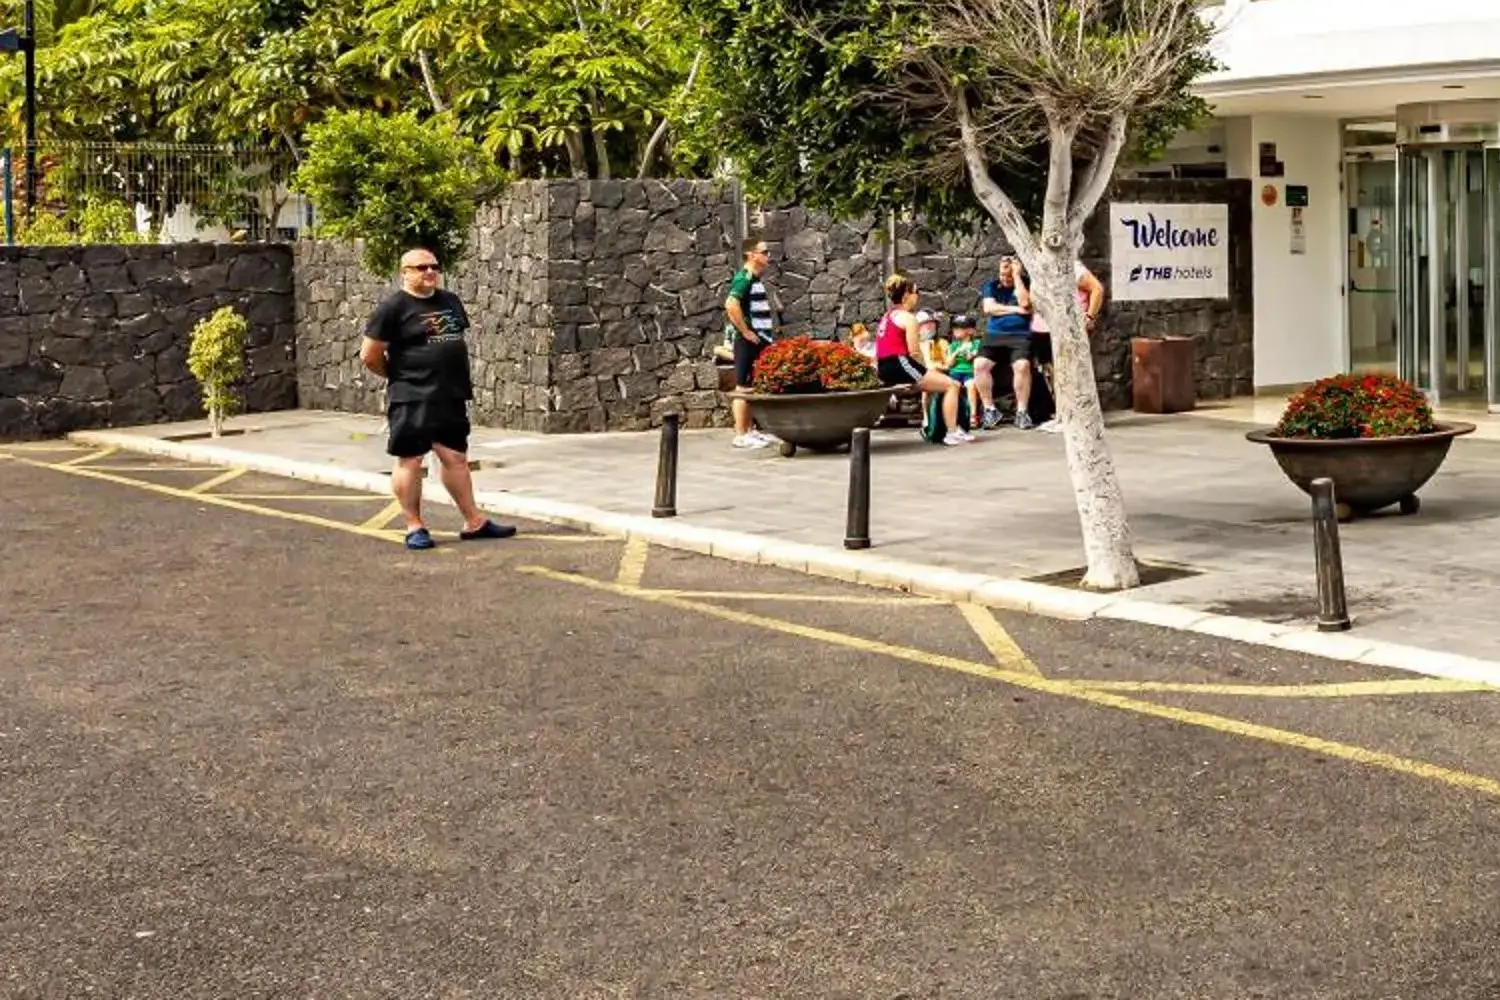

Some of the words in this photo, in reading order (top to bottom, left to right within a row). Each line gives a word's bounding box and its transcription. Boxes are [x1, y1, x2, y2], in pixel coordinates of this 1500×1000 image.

[1120, 212, 1218, 250] Welcome
[1145, 266, 1173, 280] THB
[1174, 266, 1213, 279] hotels
